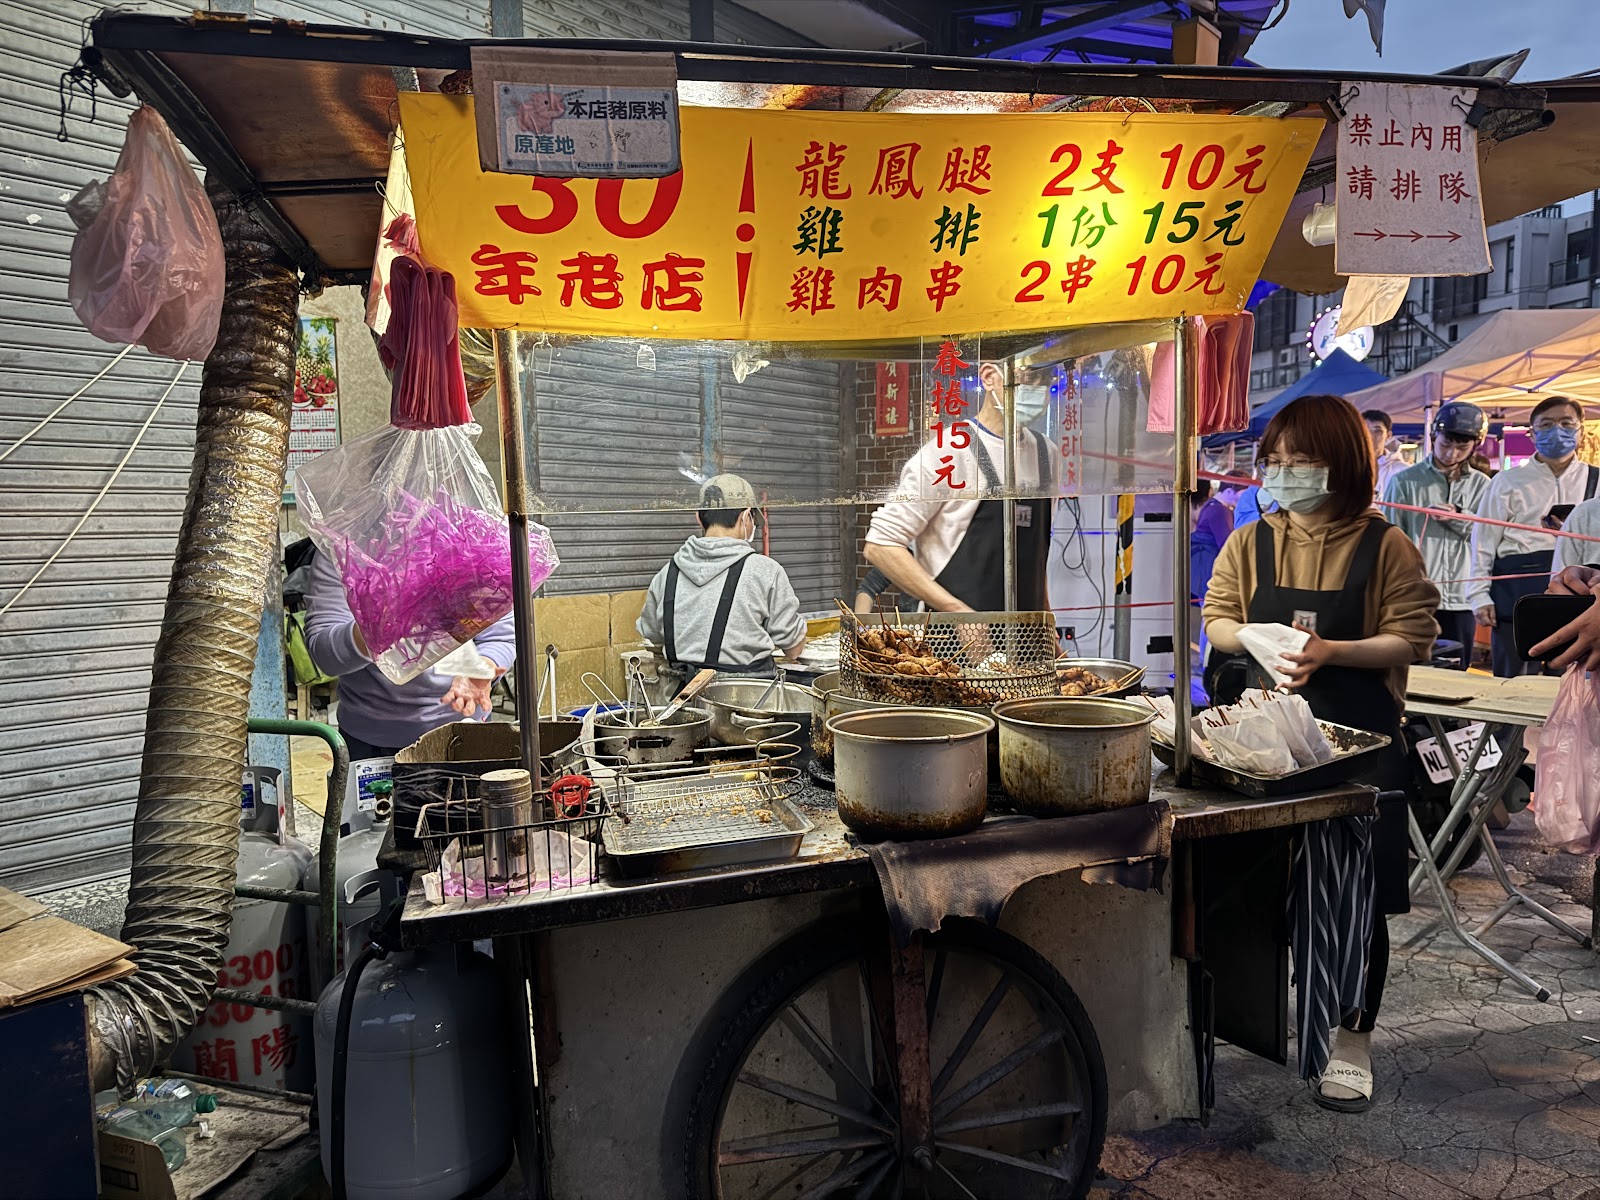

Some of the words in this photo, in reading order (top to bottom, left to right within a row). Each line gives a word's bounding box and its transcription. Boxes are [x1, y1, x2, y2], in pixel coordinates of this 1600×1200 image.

[568, 99, 667, 120] 本店豬原料
[514, 134, 575, 155] 原產地
[1349, 113, 1462, 154] 禁止內用
[795, 140, 992, 200] 龍鳳腿
[1041, 139, 1125, 197] 2支
[1160, 143, 1267, 194] 10元
[1346, 164, 1473, 205] 請排隊
[1037, 201, 1119, 249] 1份
[1142, 200, 1246, 246] 15元
[471, 243, 706, 312] 年老店
[786, 260, 964, 316] 雞肉串
[1014, 254, 1097, 305] 2串
[1126, 252, 1226, 296] 10元
